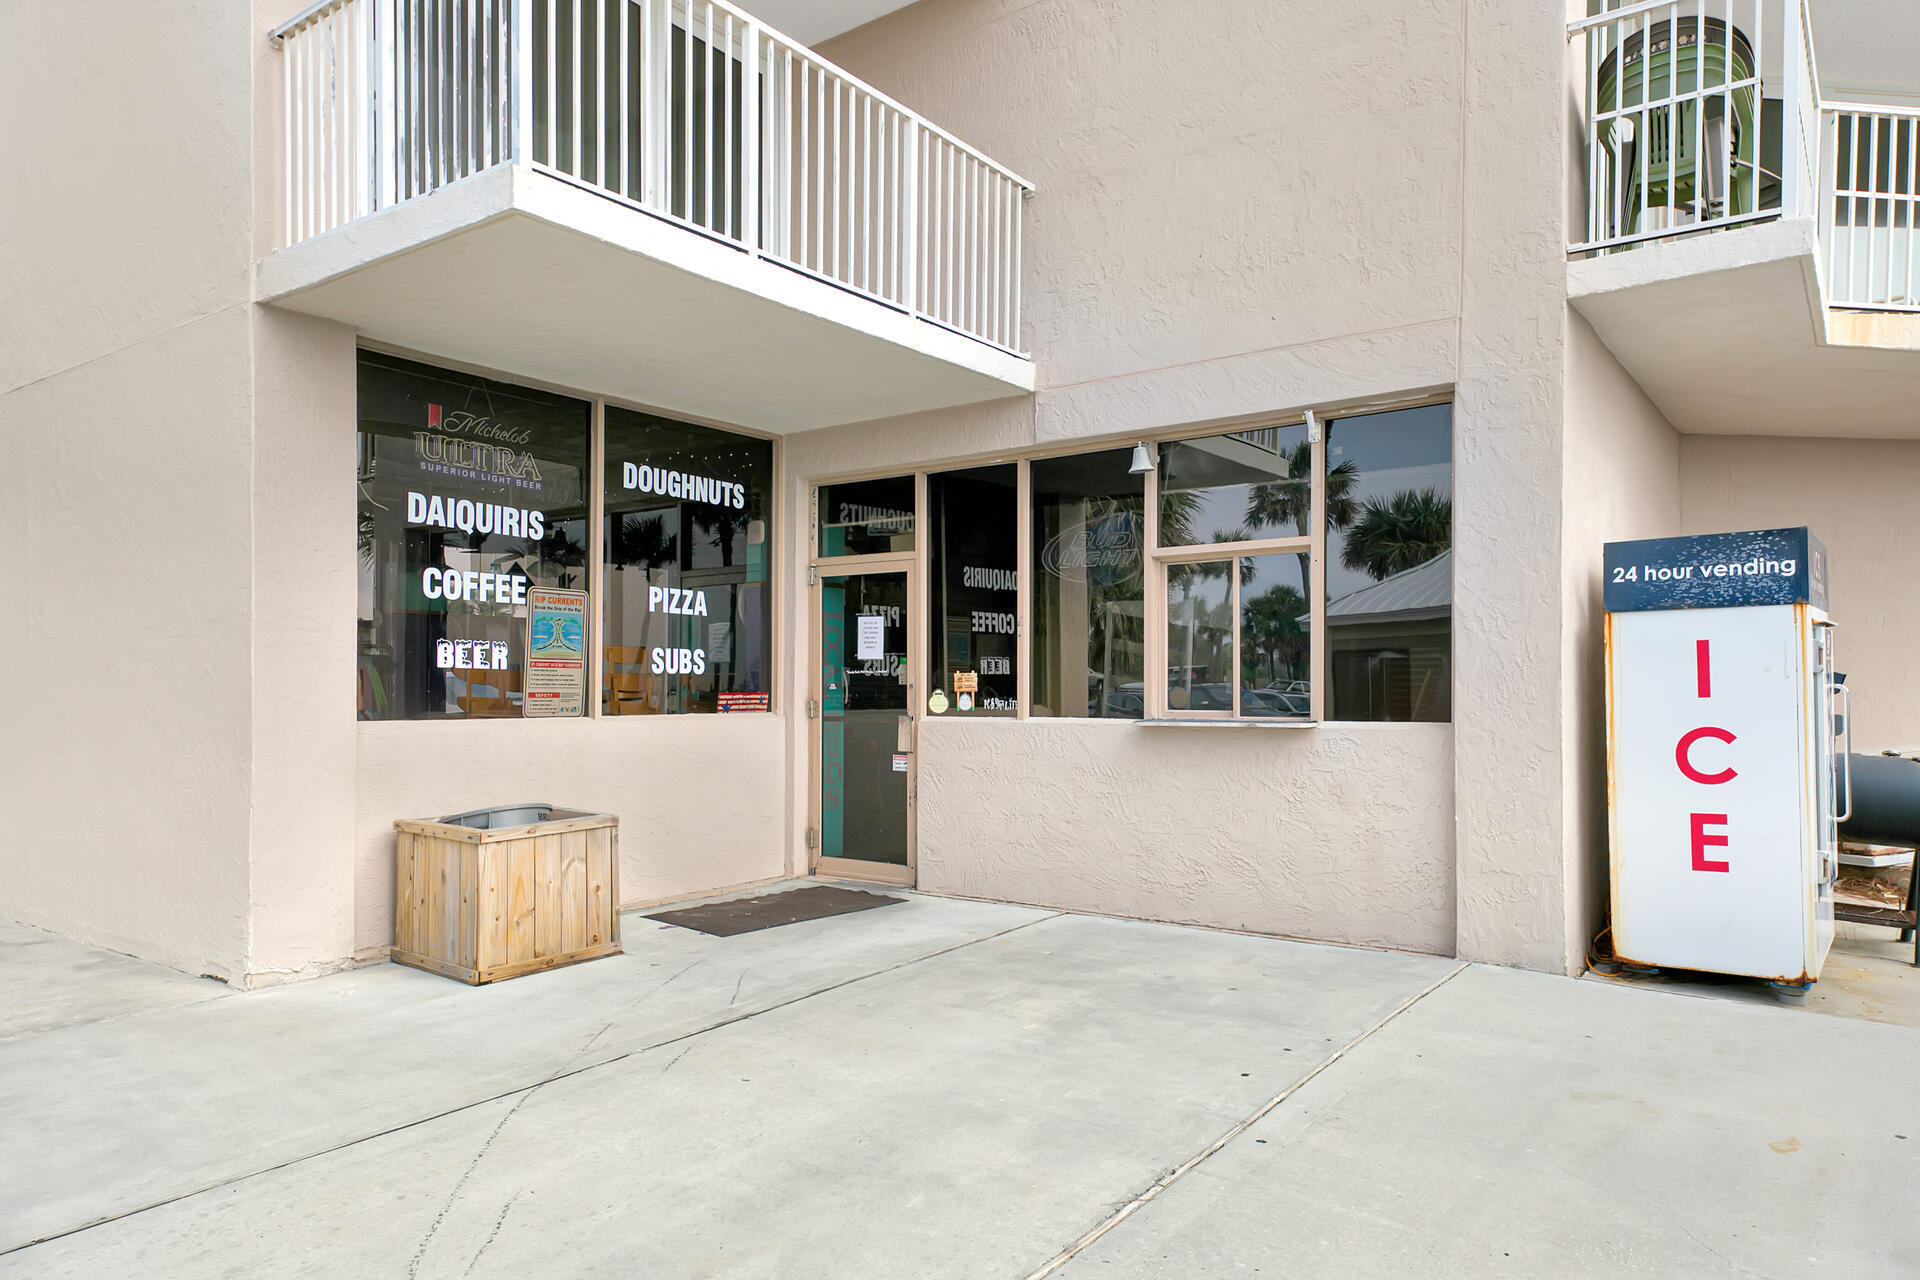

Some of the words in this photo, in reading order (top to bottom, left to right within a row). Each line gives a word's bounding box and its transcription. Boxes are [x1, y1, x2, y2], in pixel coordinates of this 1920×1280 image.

[444, 411, 531, 444] Michelob
[413, 431, 543, 481] ULTRA
[420, 462, 477, 479] SUPERIOR
[481, 472, 511, 485] LIGHT
[516, 480, 542, 491] BEER
[623, 461, 745, 510] DOUGHNUTS
[407, 491, 545, 541] DAIQUIRIS
[1070, 531, 1131, 551] BUD
[1056, 548, 1137, 569] LIGHT
[1613, 566, 1638, 583] 24
[1644, 564, 1694, 582] hour
[1700, 557, 1797, 577] vending
[422, 566, 527, 605] COFFEE
[535, 595, 546, 604] RIP
[547, 596, 583, 607] CURRENTS
[648, 586, 708, 617] PIZZA
[436, 638, 509, 670] BEER
[652, 647, 706, 675] SUBS
[1675, 639, 1738, 873] ICE
